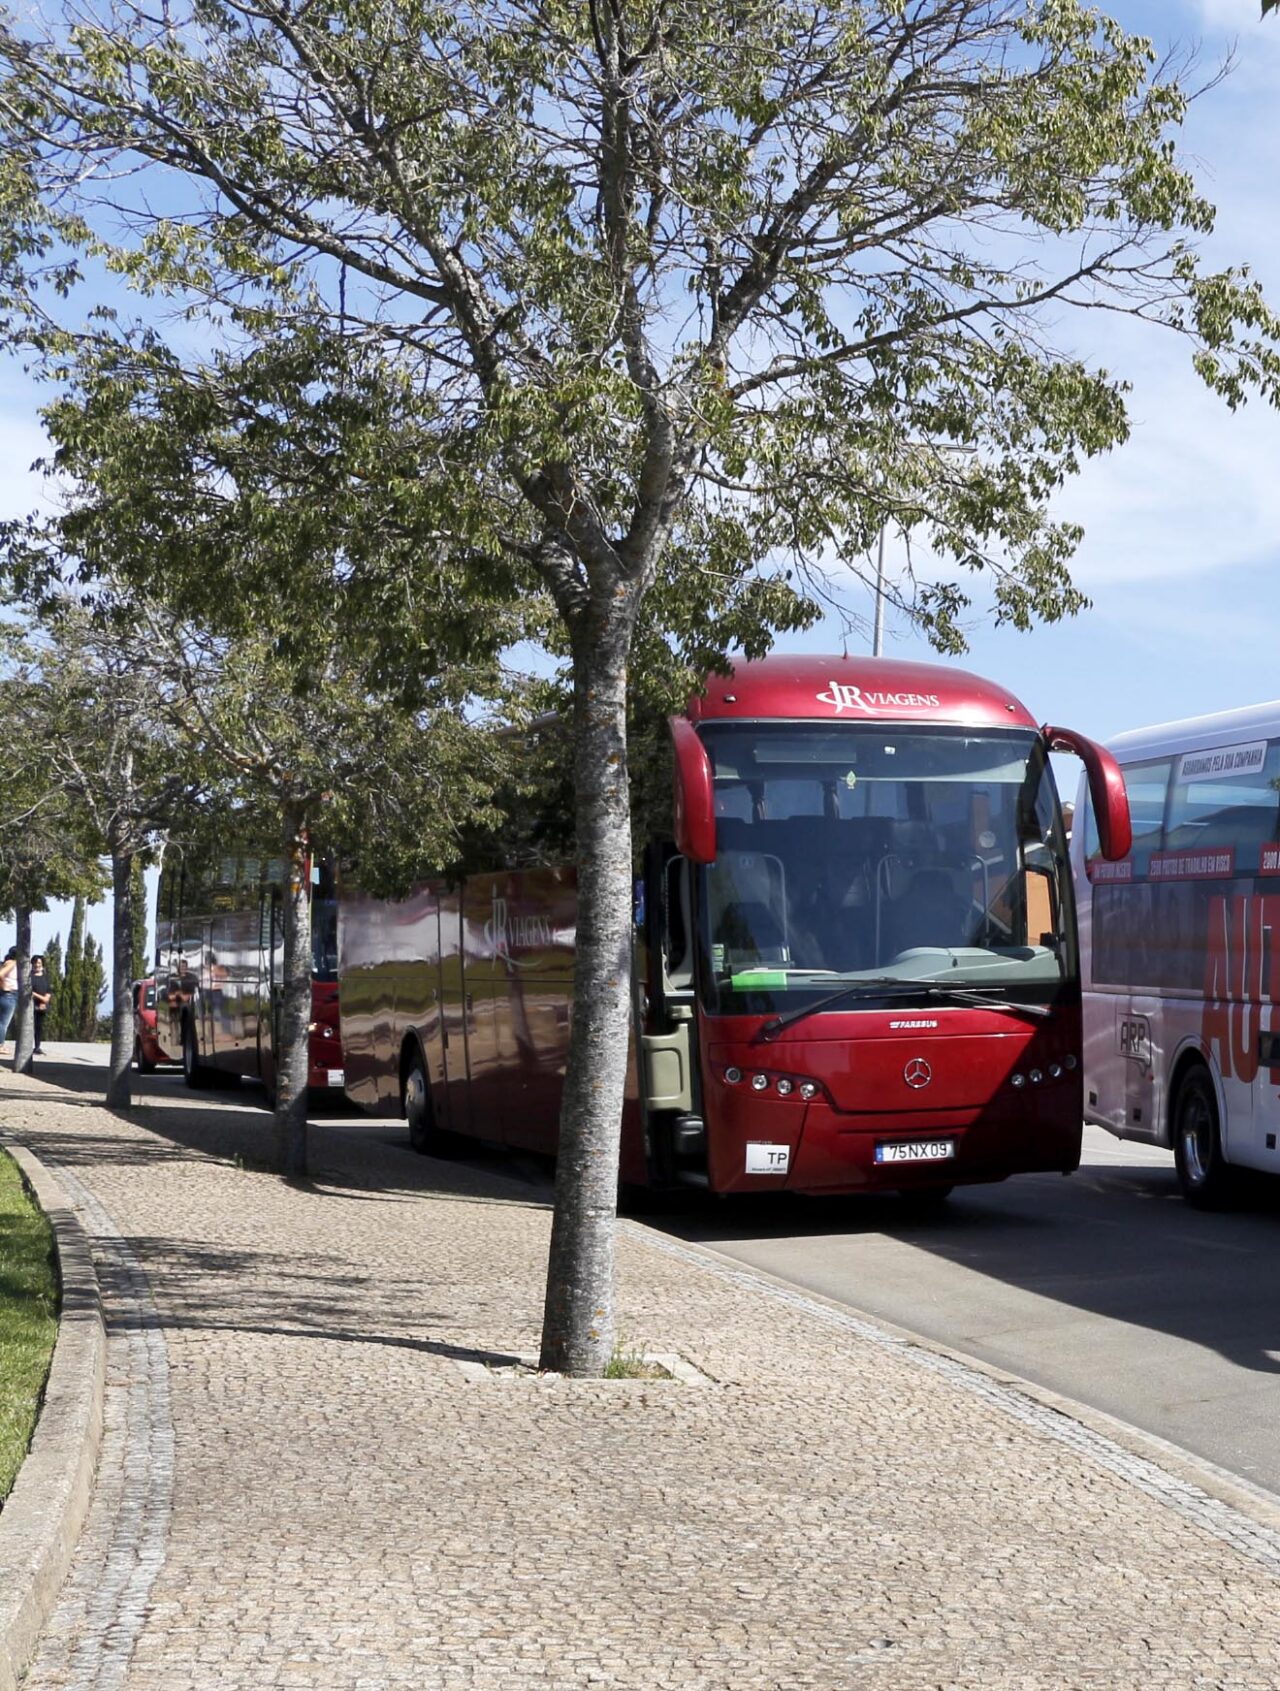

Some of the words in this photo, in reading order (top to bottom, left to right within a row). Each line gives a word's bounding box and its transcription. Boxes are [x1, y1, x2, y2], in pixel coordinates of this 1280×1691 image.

[864, 692, 940, 707] VIAGENS
[1234, 748, 1263, 768] COMPANHIA
[508, 914, 556, 948] VIAGENS
[1120, 1021, 1146, 1052] ARP
[767, 1152, 788, 1165] TP
